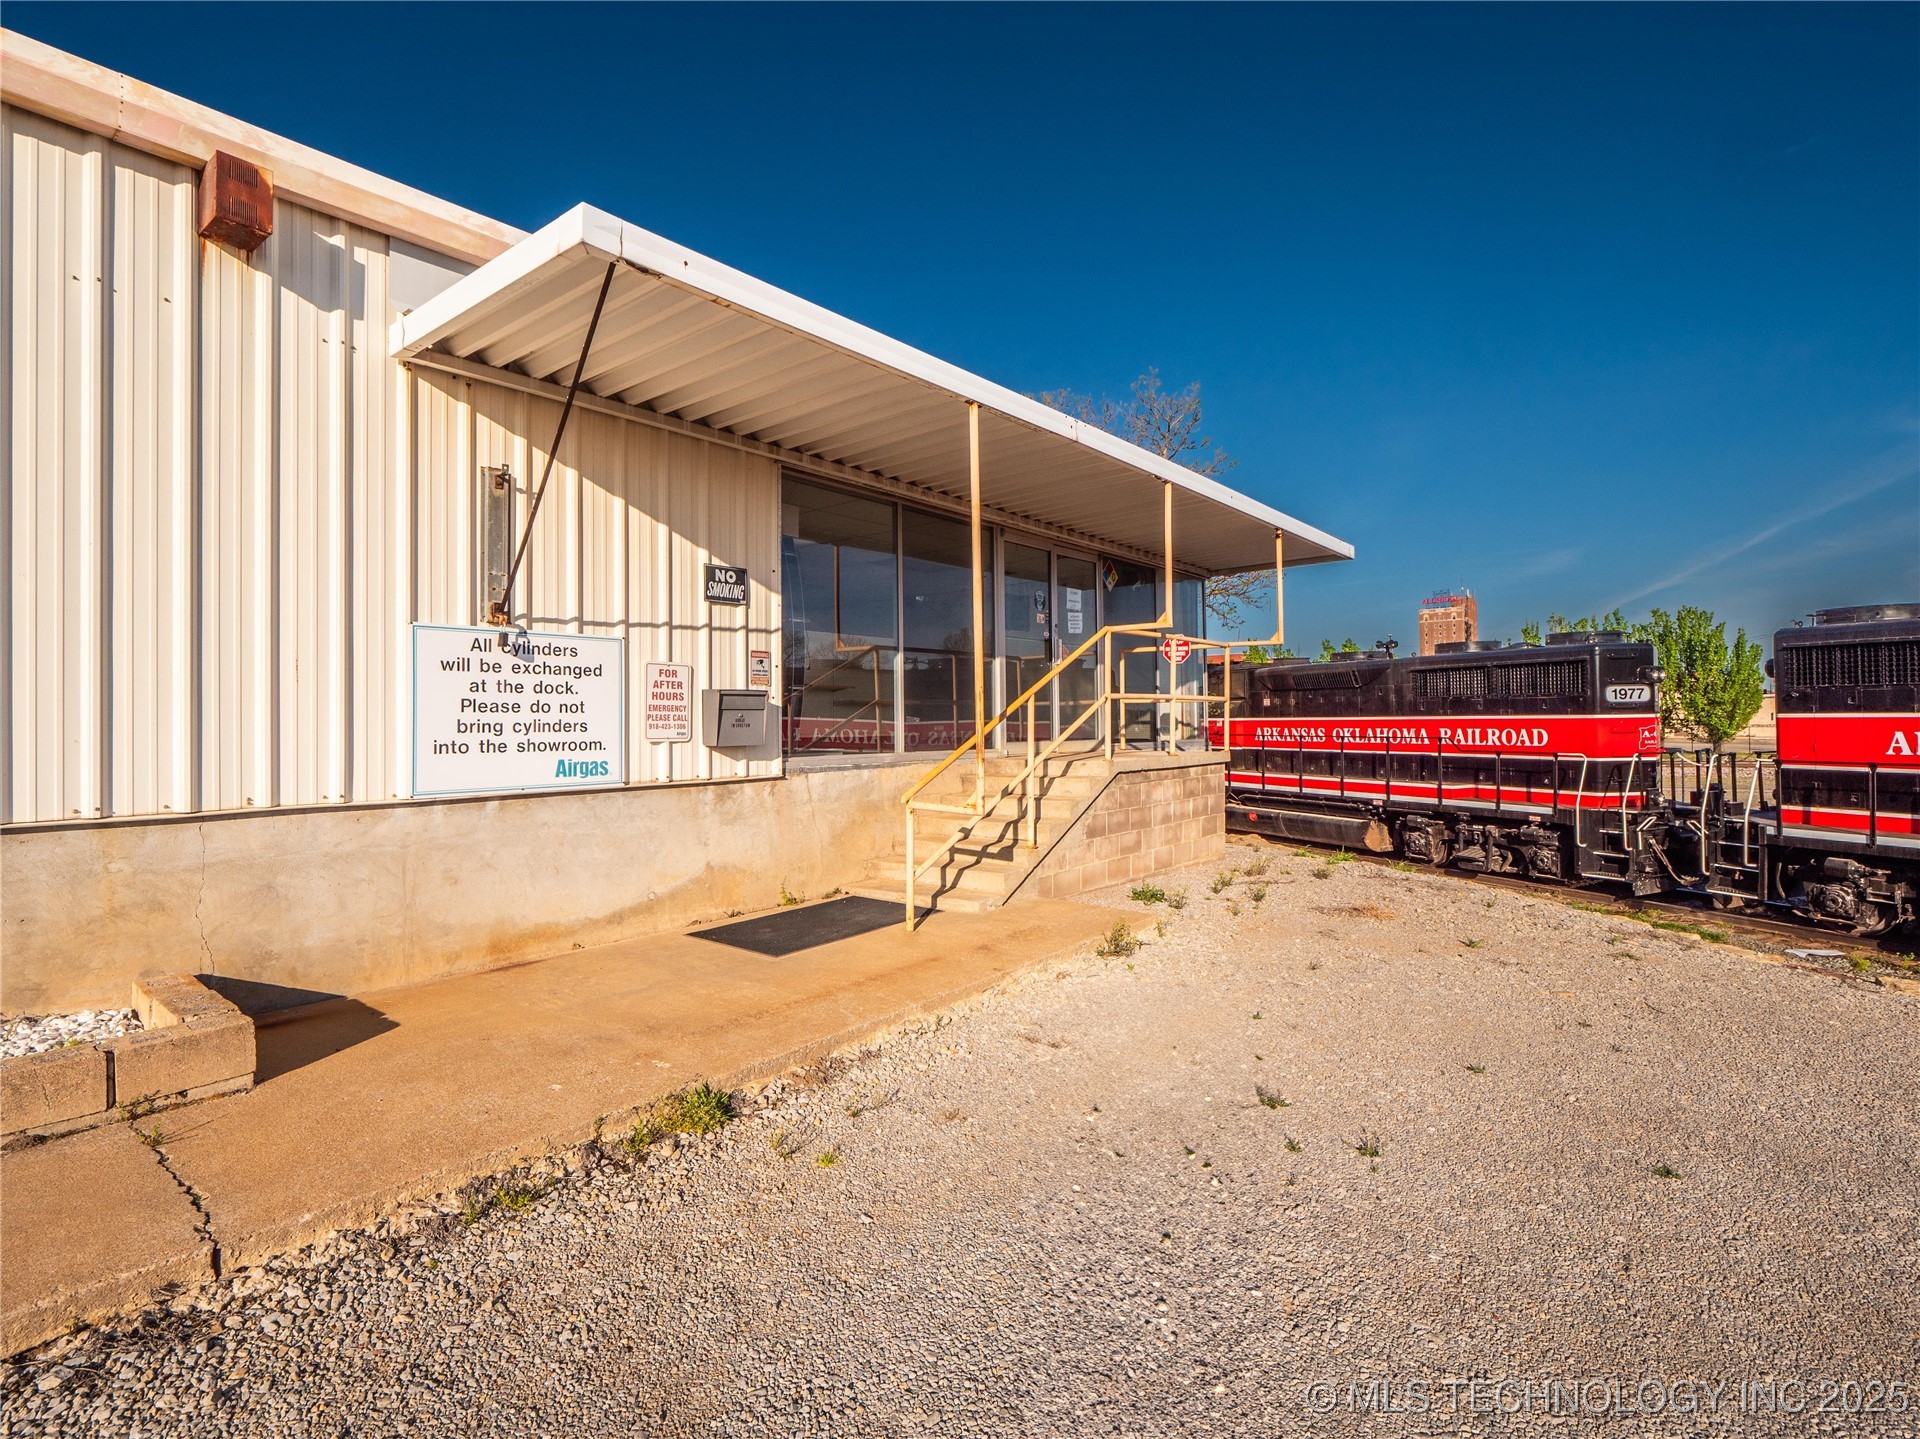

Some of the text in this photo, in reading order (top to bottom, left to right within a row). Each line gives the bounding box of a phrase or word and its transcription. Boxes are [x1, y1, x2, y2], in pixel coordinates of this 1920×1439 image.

[715, 568, 736, 583] NO
[707, 581, 745, 599] SMOKING
[470, 637, 578, 657] All cylinders
[440, 657, 603, 679] will be exchanged
[658, 669, 678, 678] FOR
[469, 679, 579, 695] at the dock.
[652, 680, 683, 690] AFTER
[652, 692, 684, 702] HOURS
[1612, 688, 1644, 700] 1977
[460, 698, 585, 713] Please do not
[457, 719, 588, 736] bring cylinders
[1254, 727, 1548, 747] ARKANSAS OKLAHOMA RAILROAD
[433, 738, 606, 754] into the showroom.
[555, 759, 609, 778] Airgas
